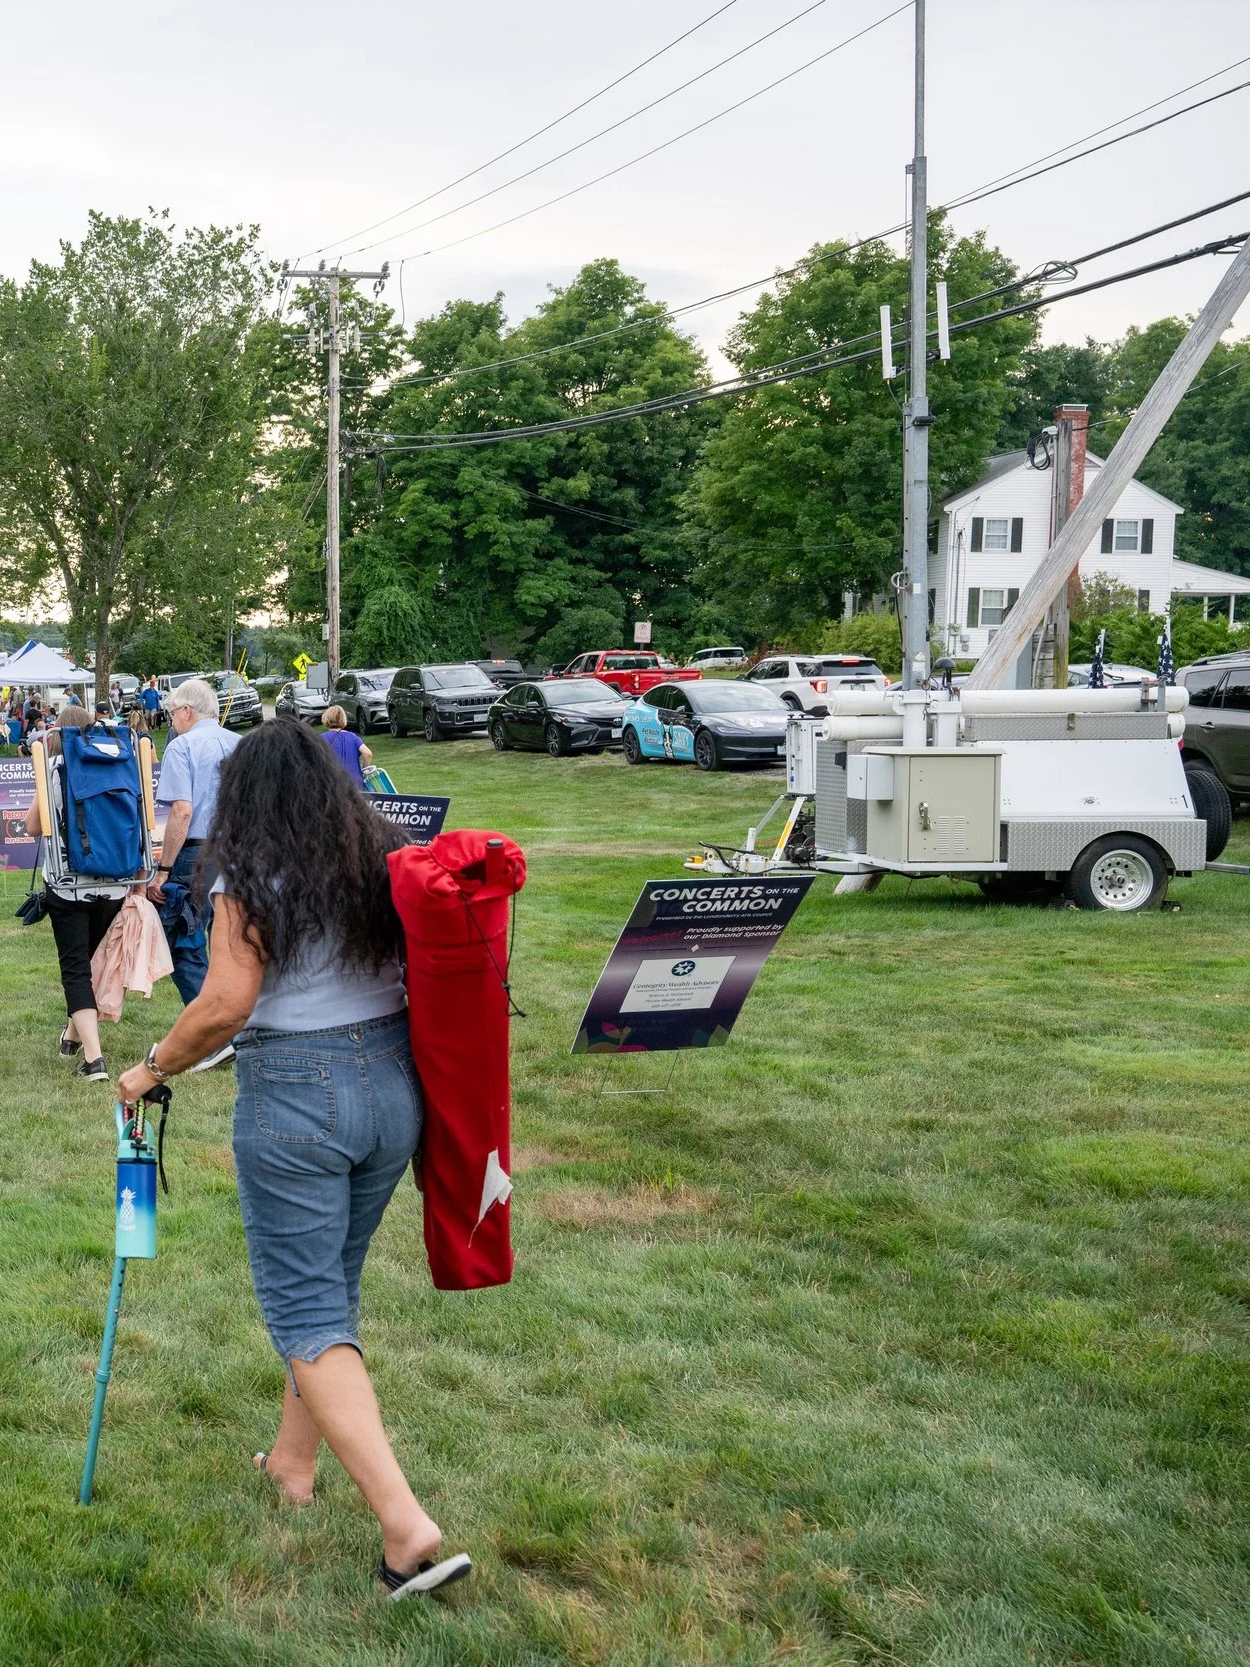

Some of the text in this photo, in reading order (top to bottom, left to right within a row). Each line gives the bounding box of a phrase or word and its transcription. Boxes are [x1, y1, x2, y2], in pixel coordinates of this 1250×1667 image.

[650, 886, 765, 901] CONCERTS
[682, 897, 783, 913] COMMON
[724, 924, 770, 933] supported
[743, 930, 782, 938] Sponsor
